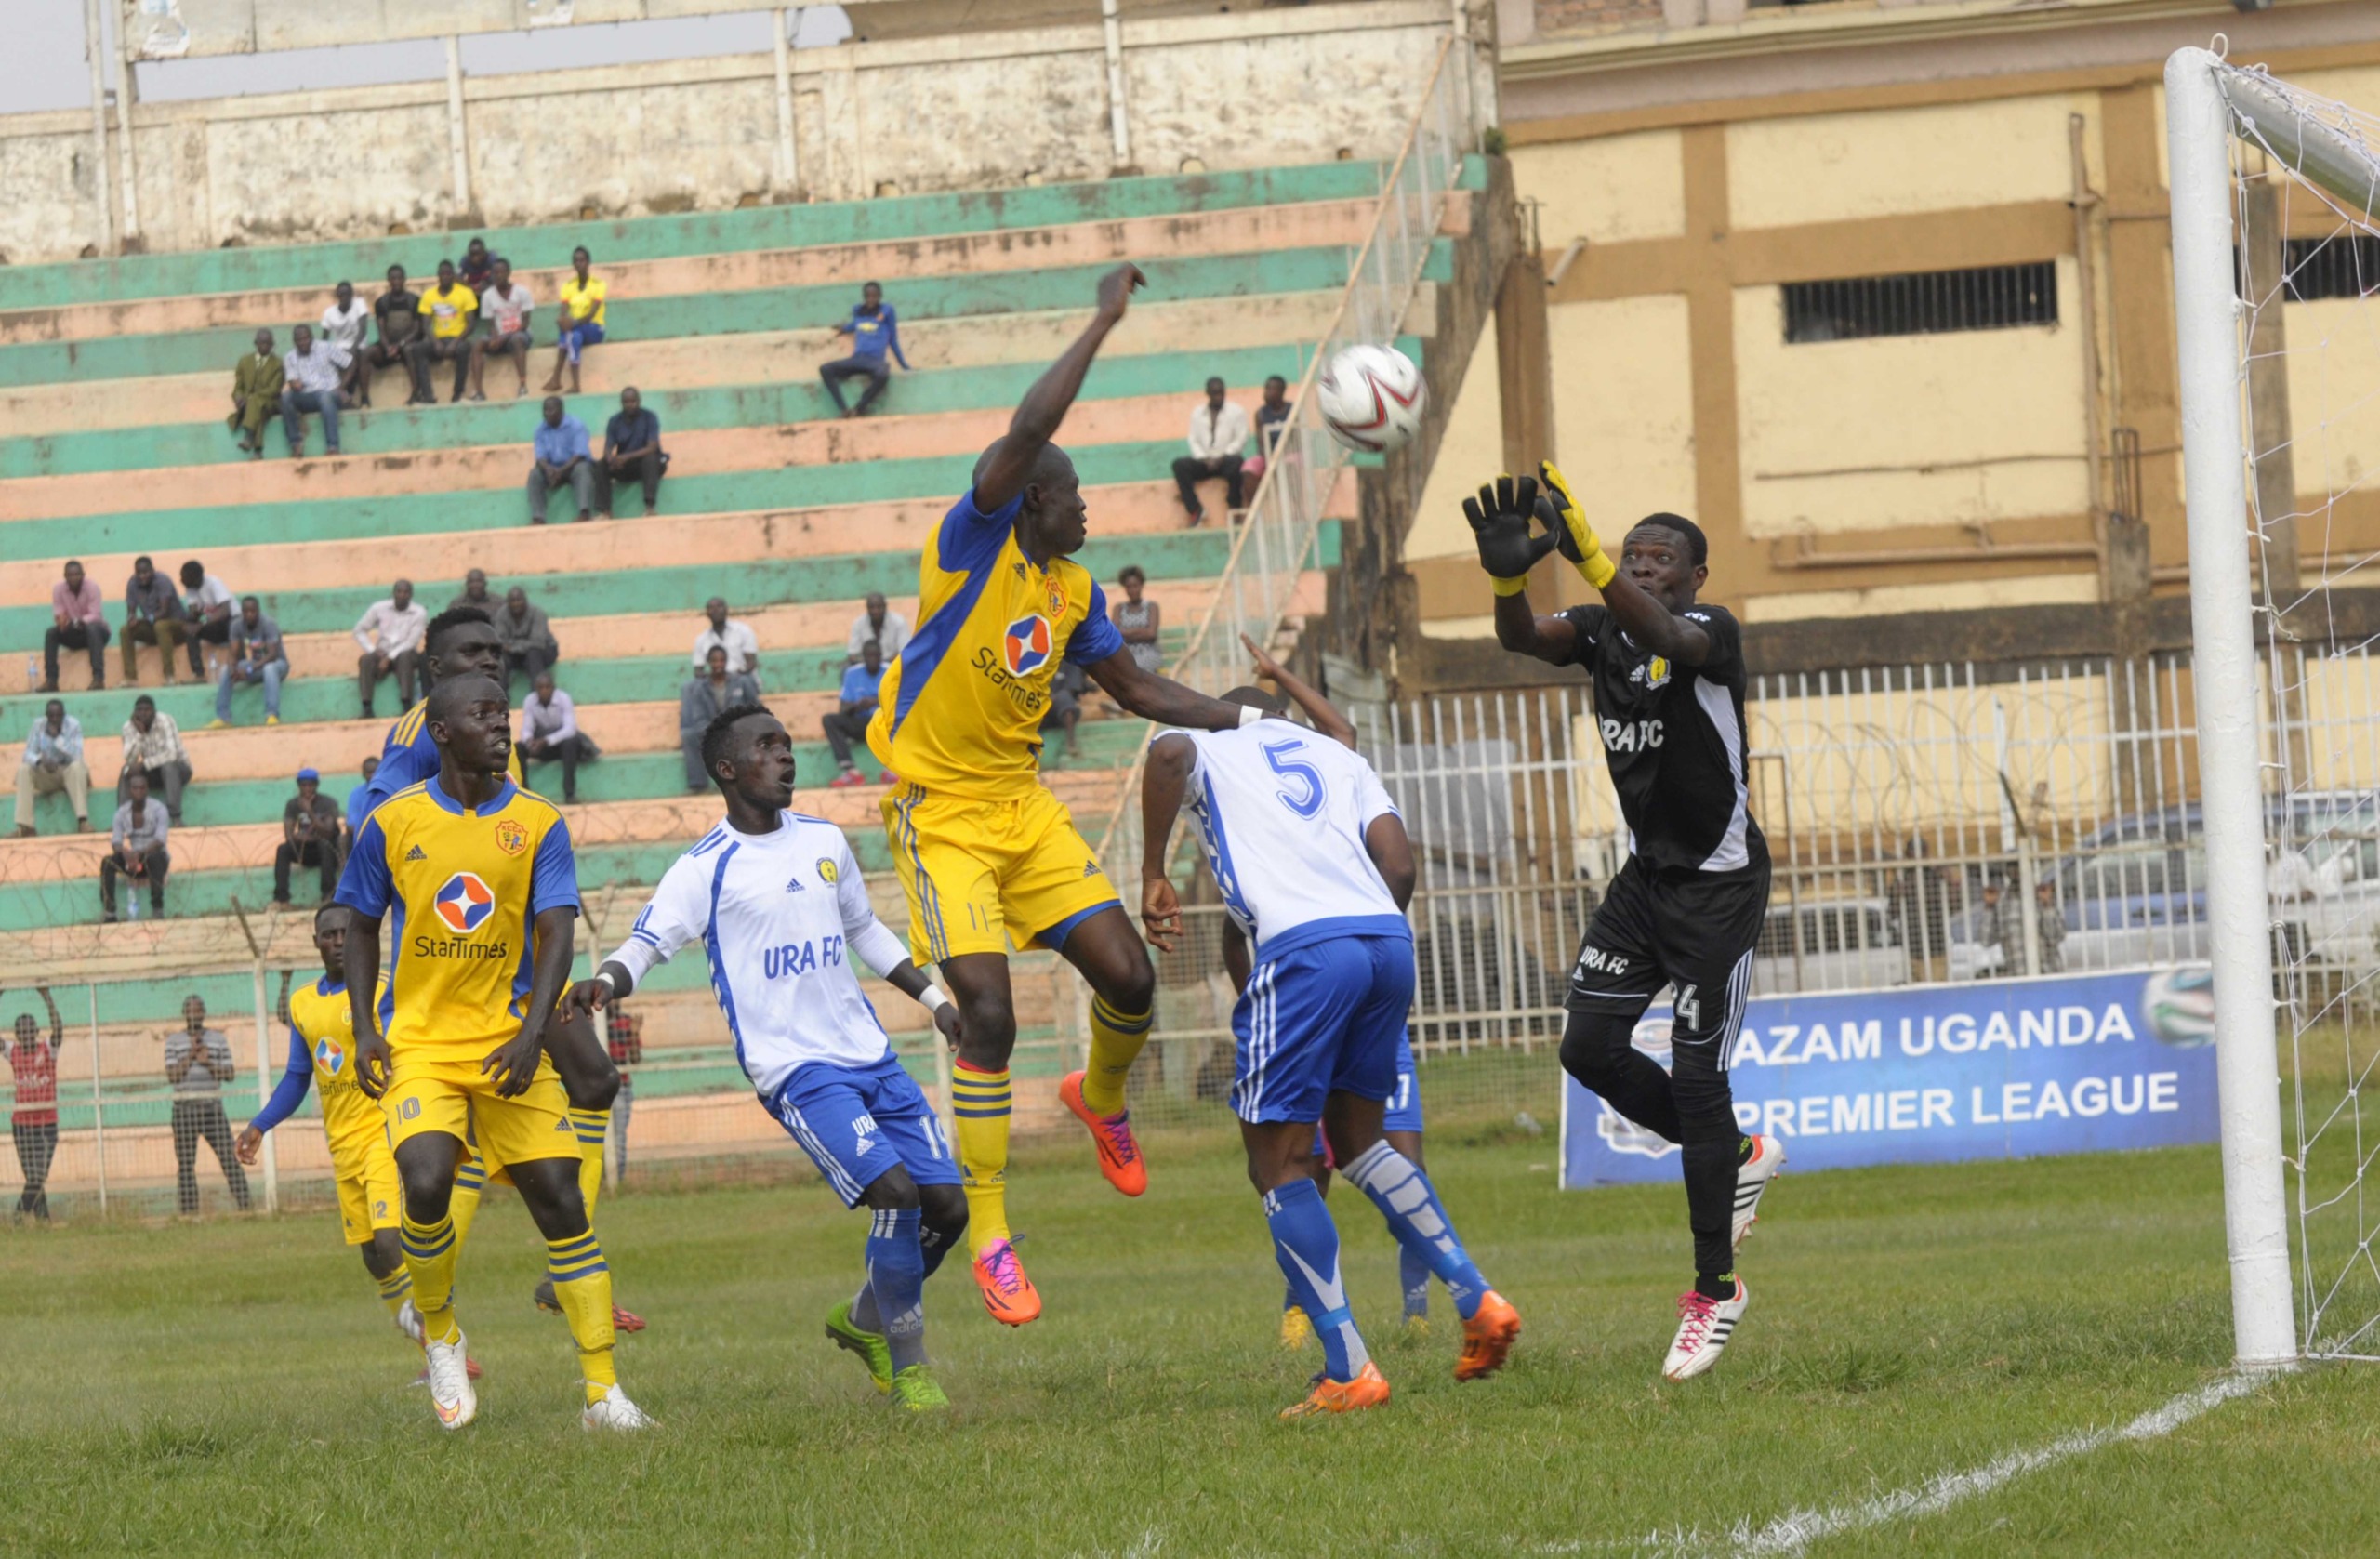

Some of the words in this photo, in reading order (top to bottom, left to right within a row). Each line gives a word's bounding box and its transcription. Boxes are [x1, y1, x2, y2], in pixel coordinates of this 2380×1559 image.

[1599, 711, 1635, 752] RA
[1638, 720, 1664, 748] FC
[1259, 738, 1328, 821] 5
[967, 902, 990, 932] 11
[415, 935, 508, 959] StarTimes
[764, 940, 816, 980] URA
[822, 934, 842, 968] FC
[1580, 945, 1607, 971] URA
[1606, 956, 1629, 975] FC
[1671, 980, 1700, 1033] 4
[1730, 1019, 1882, 1069] AZAM
[1899, 1002, 2135, 1057] UGANDA
[396, 1096, 421, 1126] 10
[1731, 1088, 1956, 1138] PREMIER
[1971, 1071, 2180, 1124] LEAGUE
[852, 1113, 879, 1138] URA
[371, 1200, 388, 1220] 12
